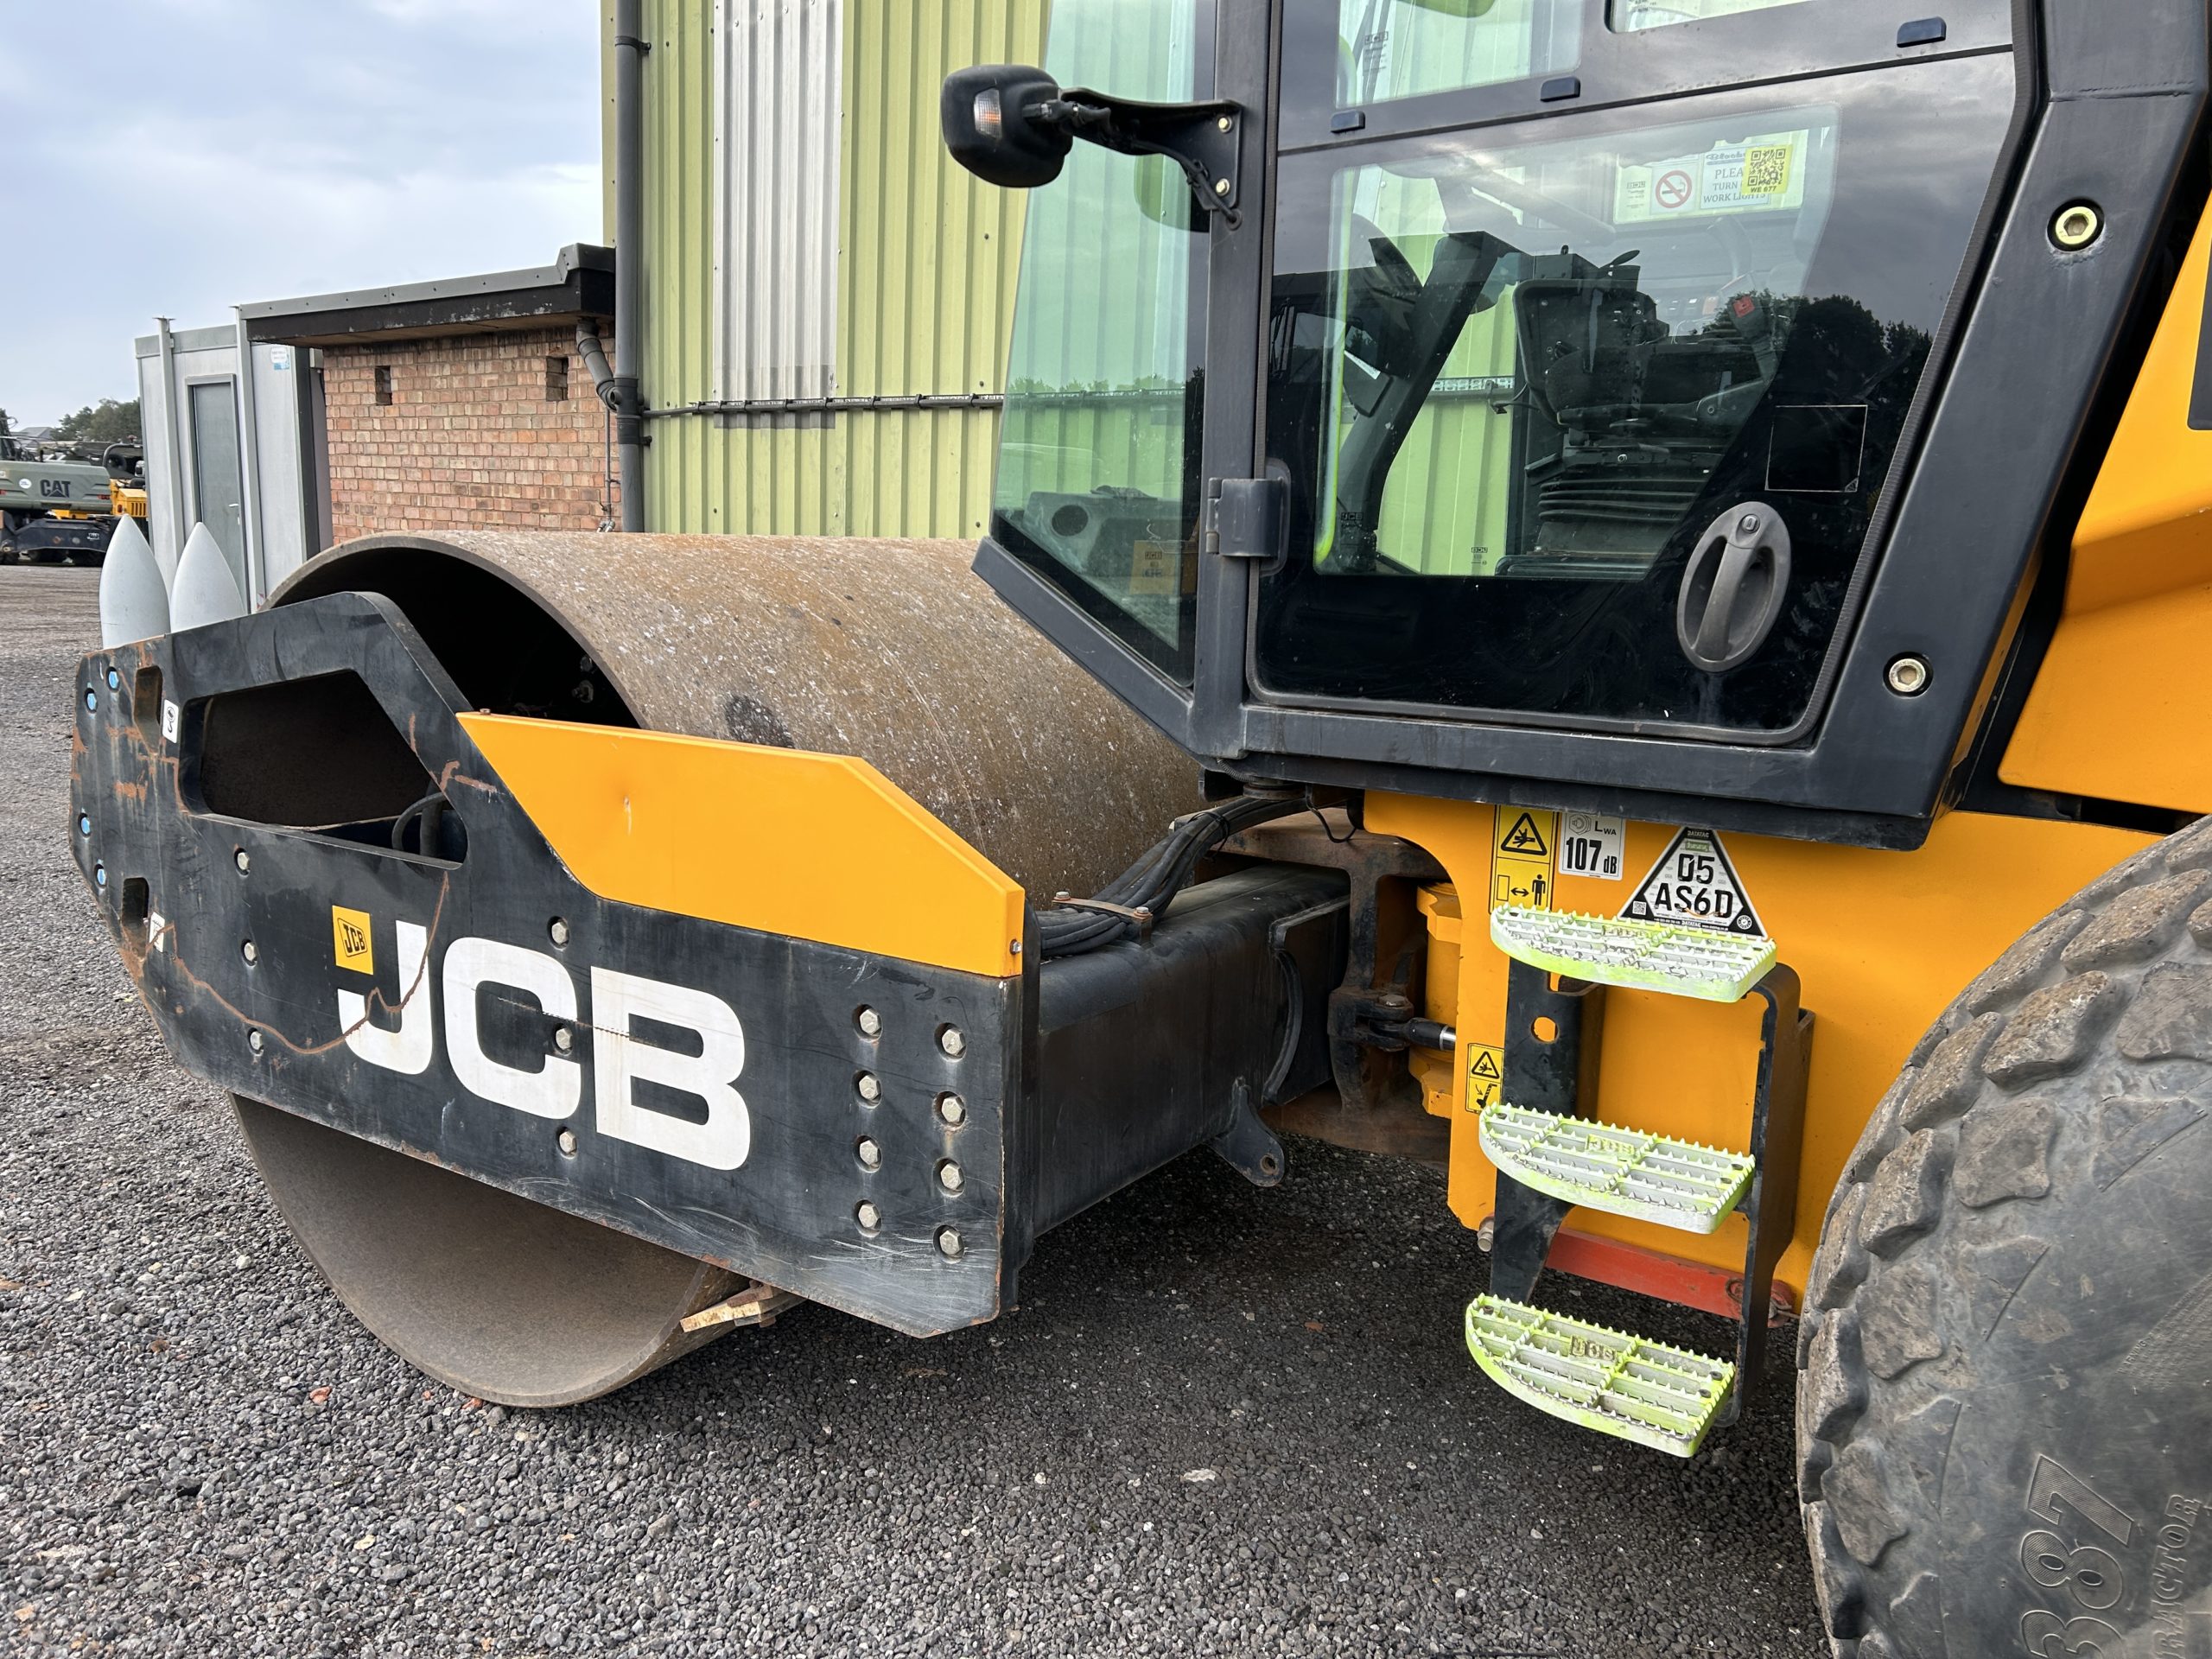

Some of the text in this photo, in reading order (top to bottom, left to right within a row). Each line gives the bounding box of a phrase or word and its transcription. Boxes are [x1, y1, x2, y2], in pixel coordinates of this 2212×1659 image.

[1713, 181, 1738, 191] TURN
[1714, 167, 1743, 180] PLEA
[1703, 194, 1732, 204] WORK
[40, 479, 71, 499] CAT
[1687, 830, 1710, 838] DATATAG
[1566, 836, 1618, 874] 107 dB
[1654, 882, 1734, 918] AS6D
[342, 923, 365, 953] JCB
[337, 919, 751, 1171] JCB
[2020, 1453, 2135, 1659] 387
[2151, 1494, 2202, 1659] RACTOR
